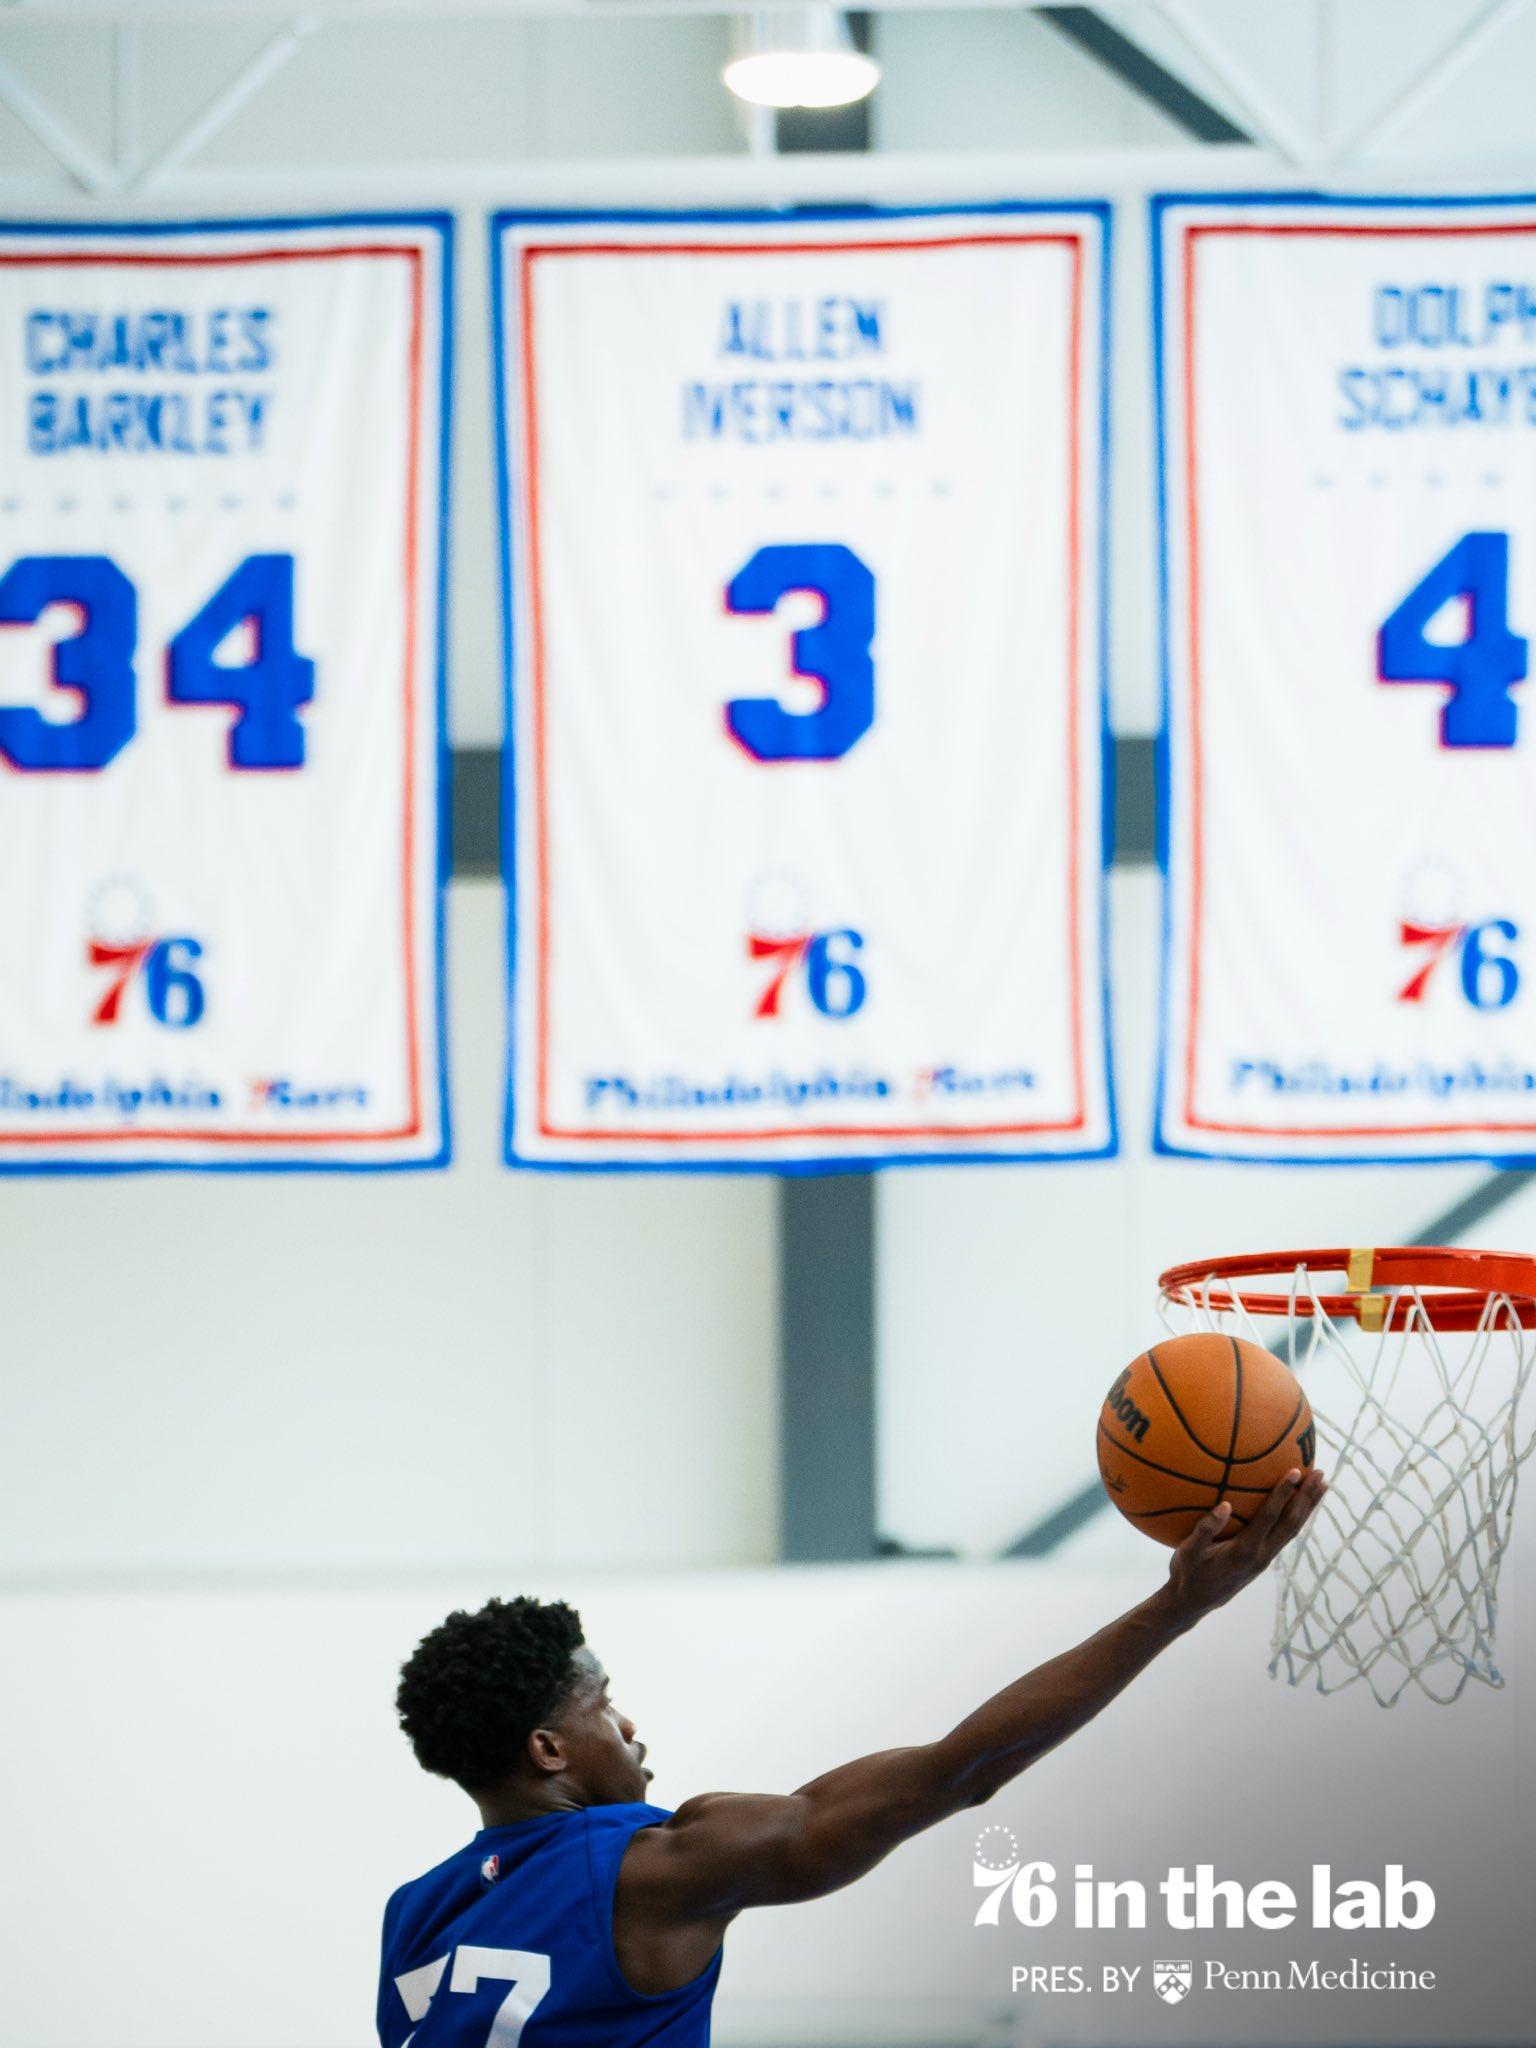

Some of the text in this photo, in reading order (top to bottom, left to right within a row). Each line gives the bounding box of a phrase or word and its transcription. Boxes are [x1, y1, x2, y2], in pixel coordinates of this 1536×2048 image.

[24, 303, 277, 377] CHARLES
[721, 296, 885, 362] ALLEN
[26, 388, 272, 458] BARKLEY
[685, 378, 919, 443] IVERSON
[0, 549, 320, 776] 34
[721, 539, 880, 768] 3
[1374, 526, 1535, 752] 4
[86, 932, 208, 1033] 76
[745, 923, 871, 1023] 76
[1396, 914, 1525, 1015] 76
